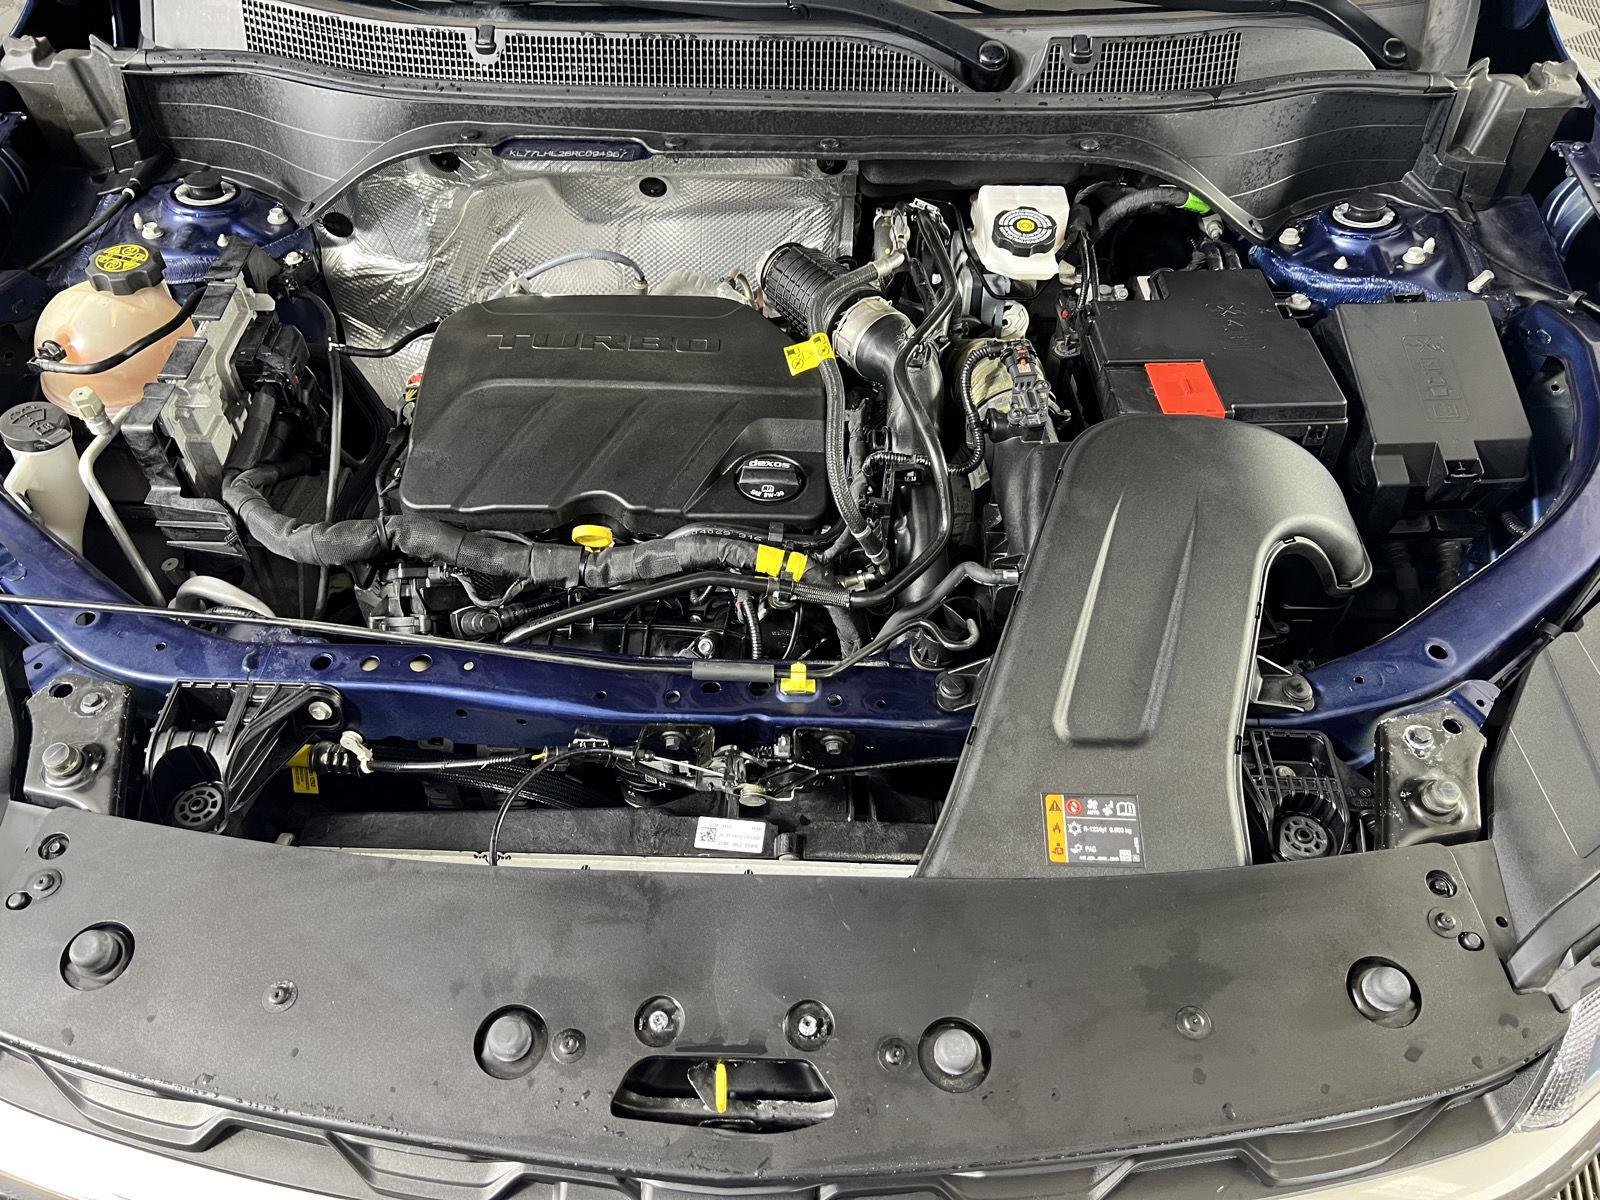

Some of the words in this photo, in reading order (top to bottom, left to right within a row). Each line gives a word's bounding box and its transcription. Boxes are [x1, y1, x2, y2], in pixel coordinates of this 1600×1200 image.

[487, 333, 721, 353] TURBO
[749, 459, 790, 468] dexos
[1085, 845, 1097, 853] PAG
